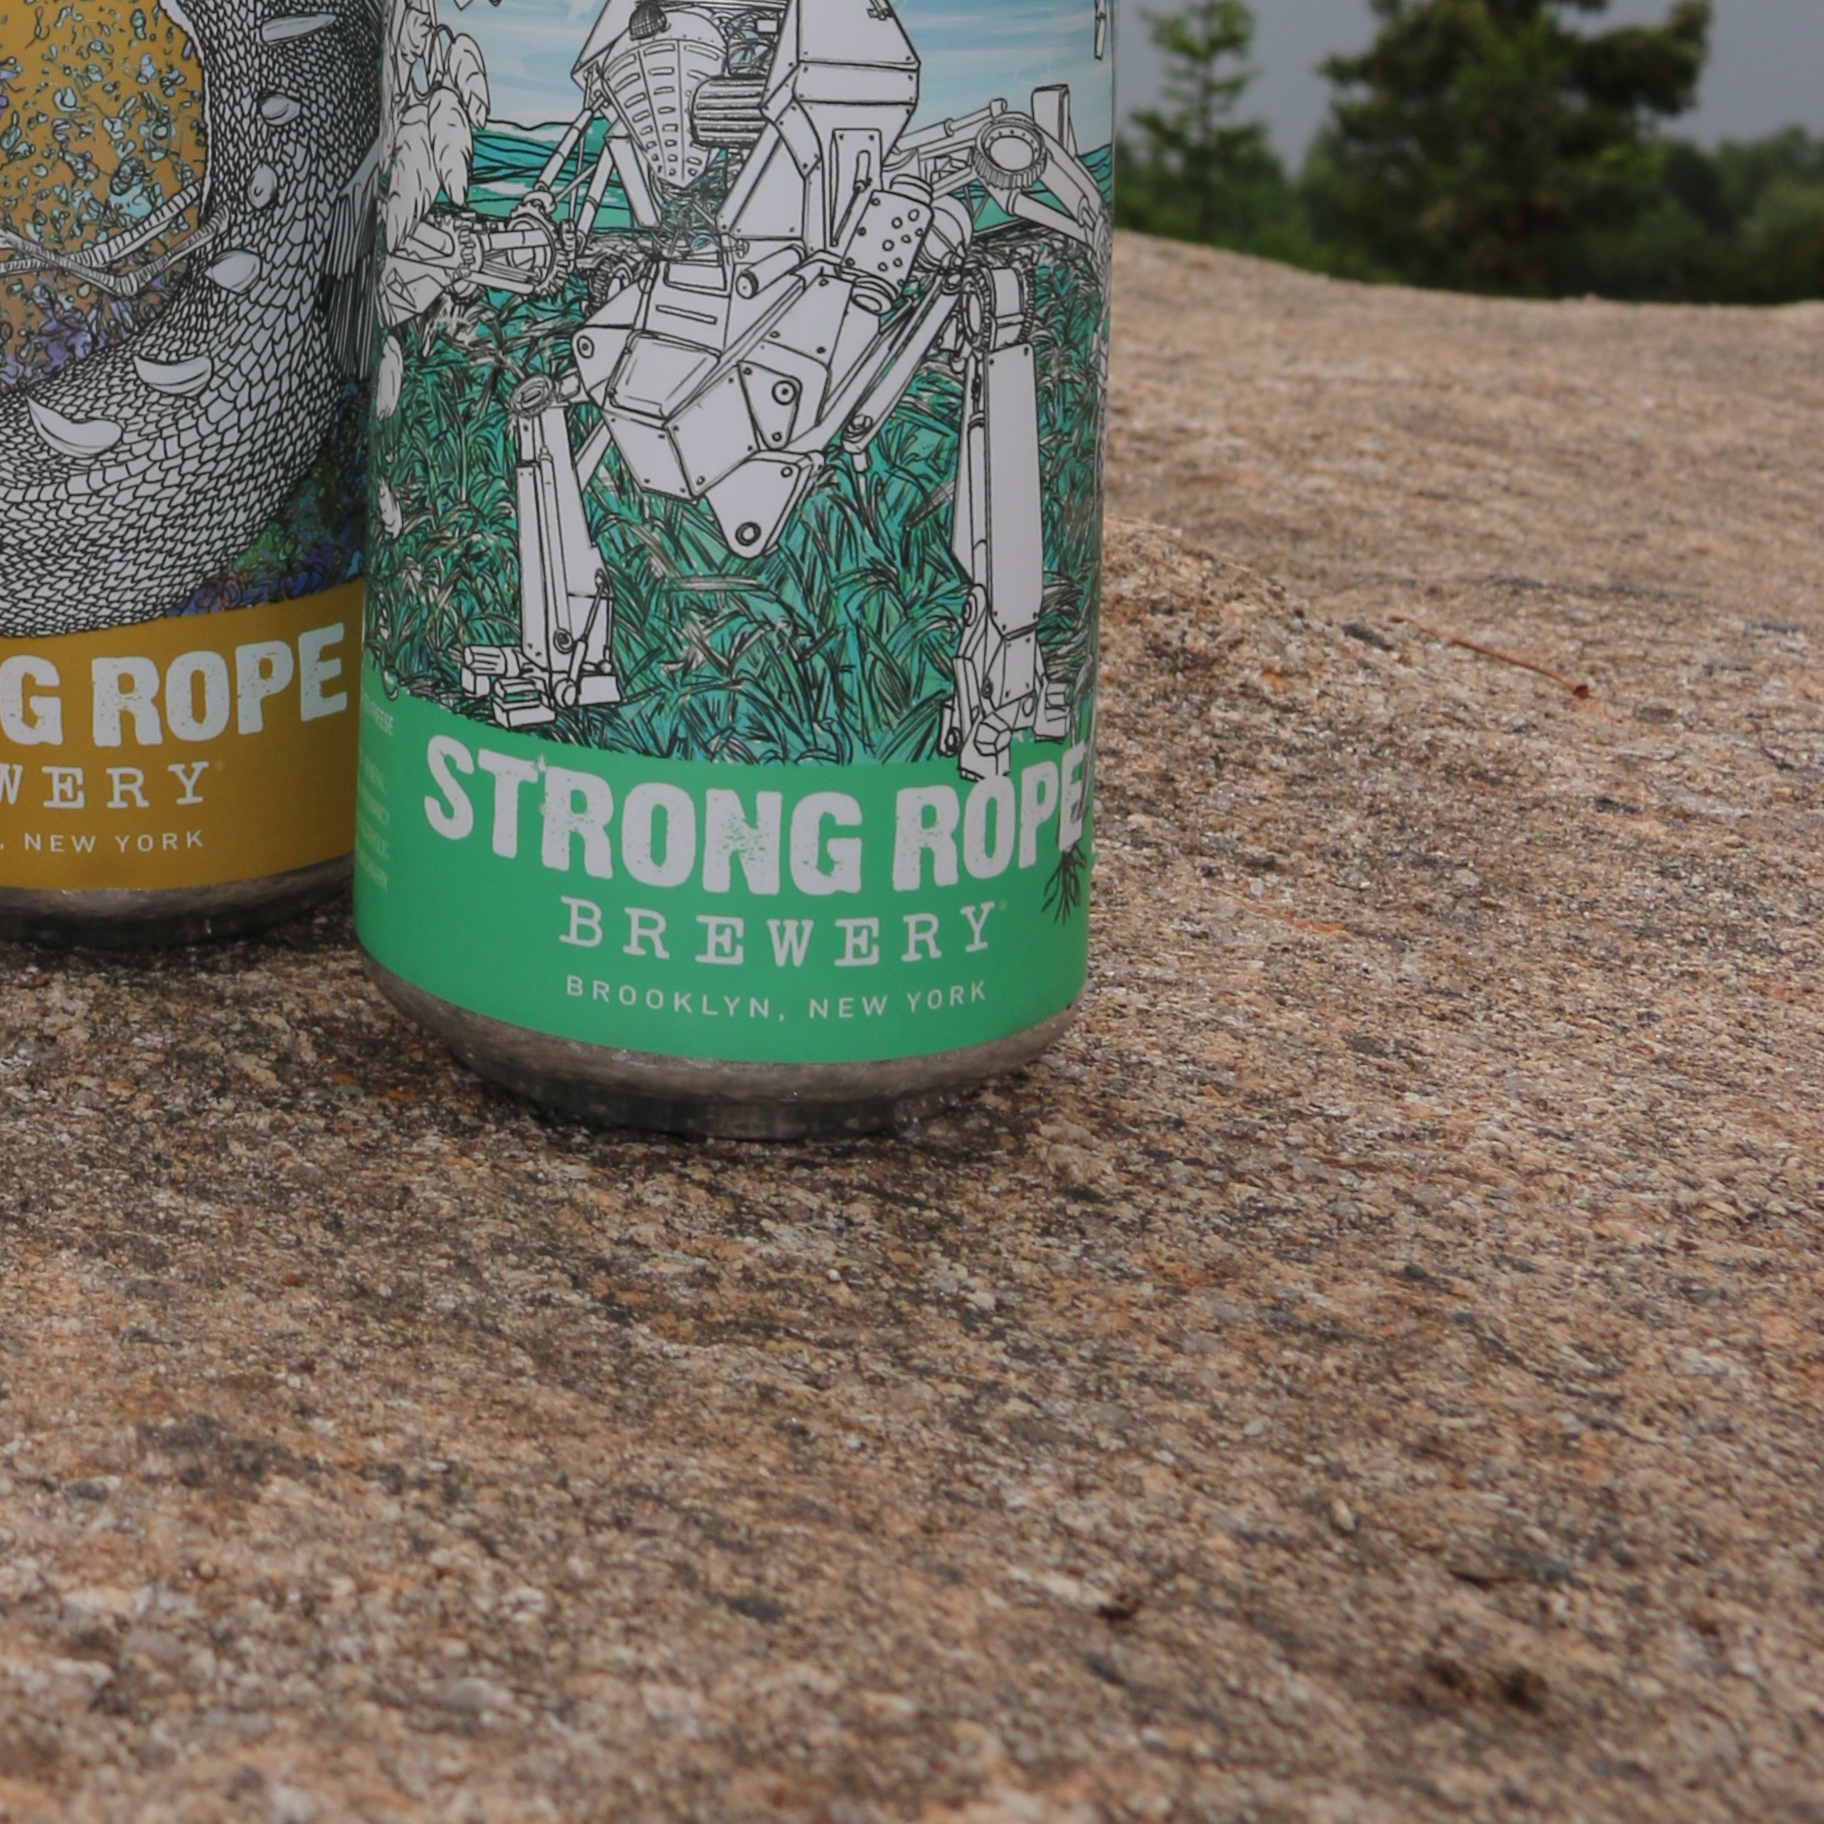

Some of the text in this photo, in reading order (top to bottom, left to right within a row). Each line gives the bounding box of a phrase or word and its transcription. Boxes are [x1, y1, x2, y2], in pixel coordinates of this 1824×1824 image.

[91, 622, 347, 747] ROPE
[25, 832, 96, 853] NEW
[115, 823, 203, 852] YORK
[424, 734, 1088, 896] STRONG ROPE
[559, 895, 995, 968] BREWERY
[566, 974, 986, 1022] BROOKLYN, NEW YORK
